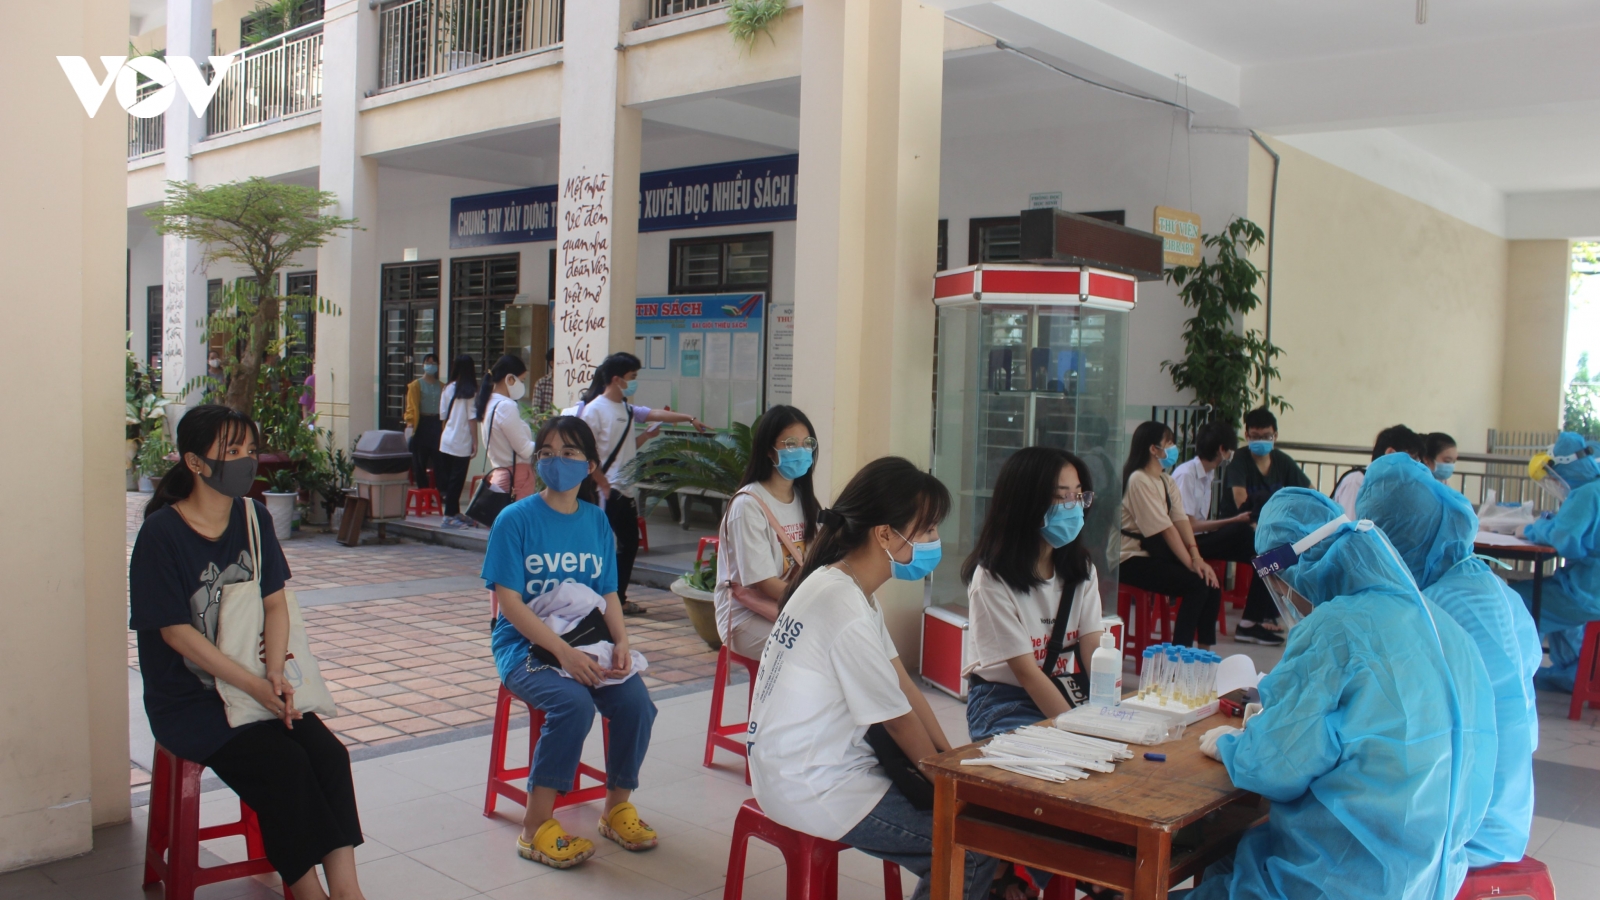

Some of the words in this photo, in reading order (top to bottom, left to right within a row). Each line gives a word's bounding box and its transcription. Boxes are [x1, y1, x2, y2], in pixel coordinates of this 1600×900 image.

[644, 181, 683, 219] XUYÊN
[685, 183, 709, 220] ĐỌC
[712, 169, 751, 212] NHIỀU
[754, 170, 790, 209] SÁCH
[457, 209, 486, 237] CHUNG
[488, 207, 503, 234] TAY
[503, 201, 522, 232] XÂY
[523, 201, 549, 236] DỰNG
[1158, 216, 1178, 235] THƯ
[1179, 219, 1199, 240] VIỆN
[636, 303, 659, 317] TIN
[661, 298, 703, 317] SÁCH
[525, 551, 603, 579] every
[526, 576, 578, 596] on
[777, 611, 804, 638] ANS
[771, 627, 797, 650] ASS
